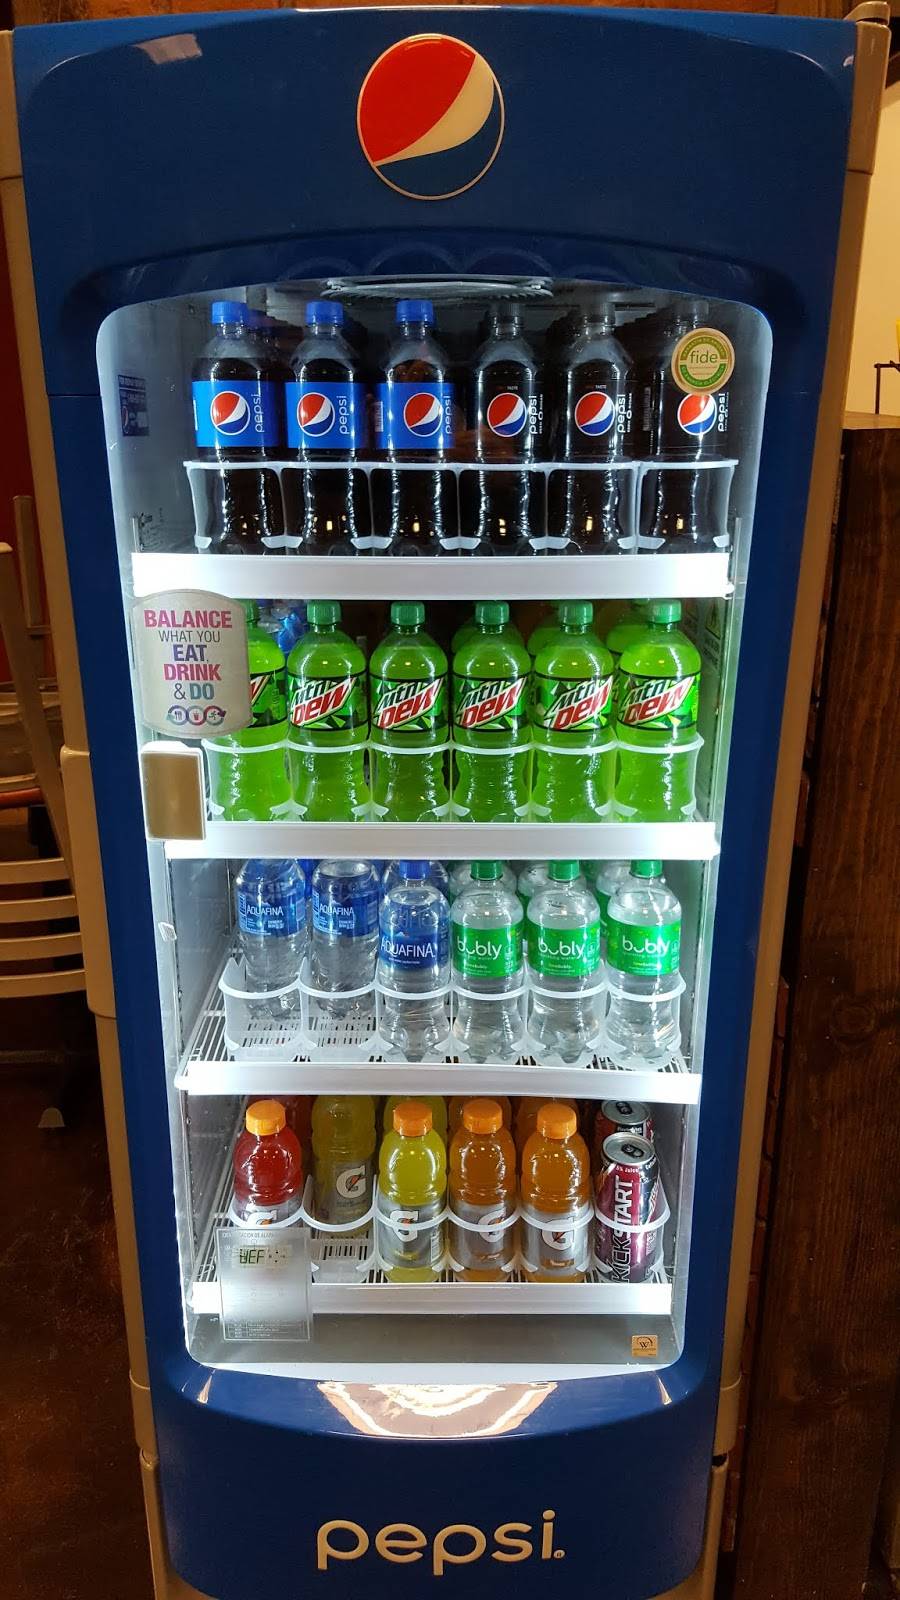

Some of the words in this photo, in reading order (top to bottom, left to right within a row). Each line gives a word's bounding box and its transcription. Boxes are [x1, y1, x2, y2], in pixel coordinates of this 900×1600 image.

[690, 350, 718, 364] fide
[251, 393, 265, 433] pepsi
[336, 395, 349, 435] pepsi
[443, 395, 452, 434] pepsi
[528, 395, 538, 435] pepsi
[616, 393, 626, 433] pepsi
[717, 393, 726, 432] pepsi
[143, 609, 233, 629] BALANCE
[158, 630, 193, 642] WHAT
[196, 630, 221, 643] YOU
[163, 663, 222, 681] DRINK
[173, 682, 186, 700] &
[189, 682, 215, 700] DO
[246, 904, 285, 917] AQUAFINA
[319, 903, 355, 916] AQUAFINA
[380, 935, 434, 958] AQUAFINA
[456, 935, 503, 960] bubly
[537, 936, 586, 960] bubly
[316, 1509, 556, 1576] pepsi
